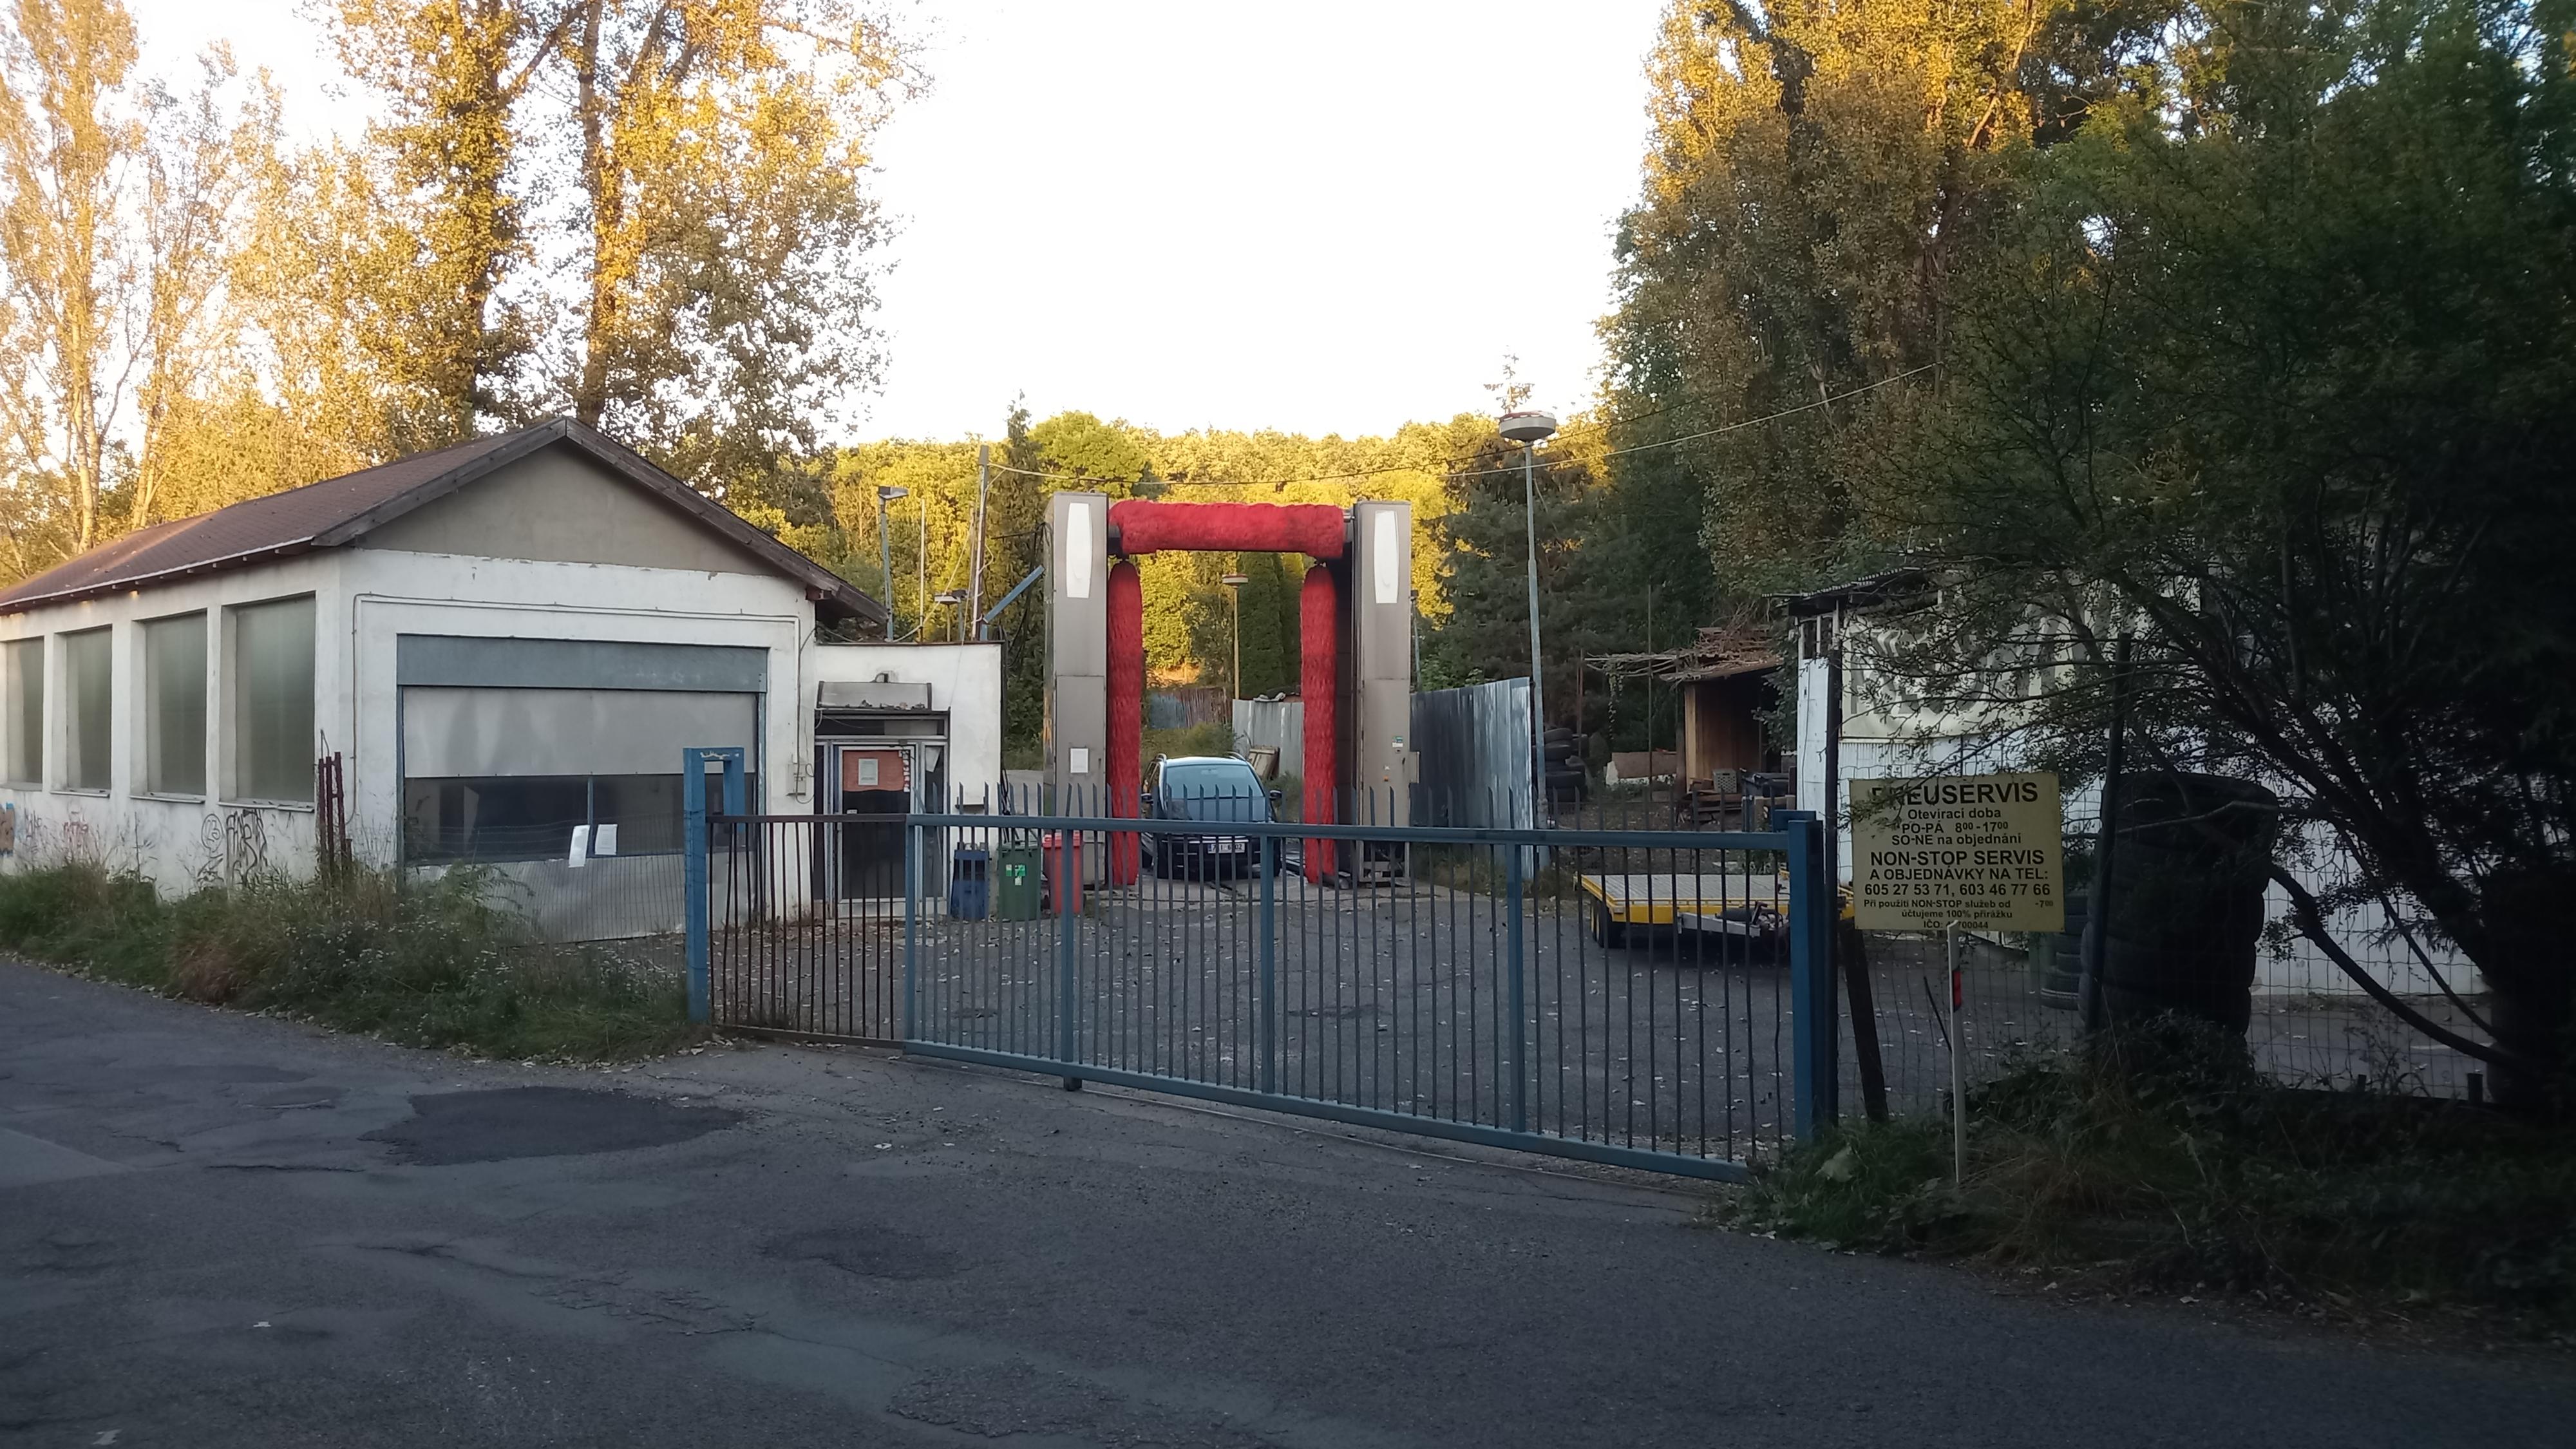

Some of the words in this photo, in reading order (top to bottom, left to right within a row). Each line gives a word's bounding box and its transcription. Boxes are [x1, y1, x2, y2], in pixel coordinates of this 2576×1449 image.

[1969, 807, 2001, 818] doba
[1902, 820, 1944, 834] PO-PÁ
[1891, 835, 1933, 845] SO-NE
[1956, 833, 2022, 847] objednání
[1871, 851, 1967, 866] NON-STOP
[1974, 849, 2044, 865] SERVIS
[1870, 869, 1880, 880] A
[1884, 865, 1984, 880] OBJEDNÁVKY
[1990, 868, 2011, 880] NA
[2015, 868, 2048, 880] TEL:
[1865, 884, 1889, 895] 605
[1893, 884, 1909, 895] 27
[1914, 884, 1930, 895] 53
[1934, 884, 1955, 897] 71,
[1960, 884, 1984, 895] 603
[1989, 884, 2006, 895] 46
[2011, 884, 2028, 895] 77
[2033, 884, 2050, 895] 66
[1864, 899, 1876, 907] Při
[1965, 900, 1996, 908] služeb
[1902, 909, 1944, 919] účtujeme
[1924, 919, 1943, 928] IČO:
